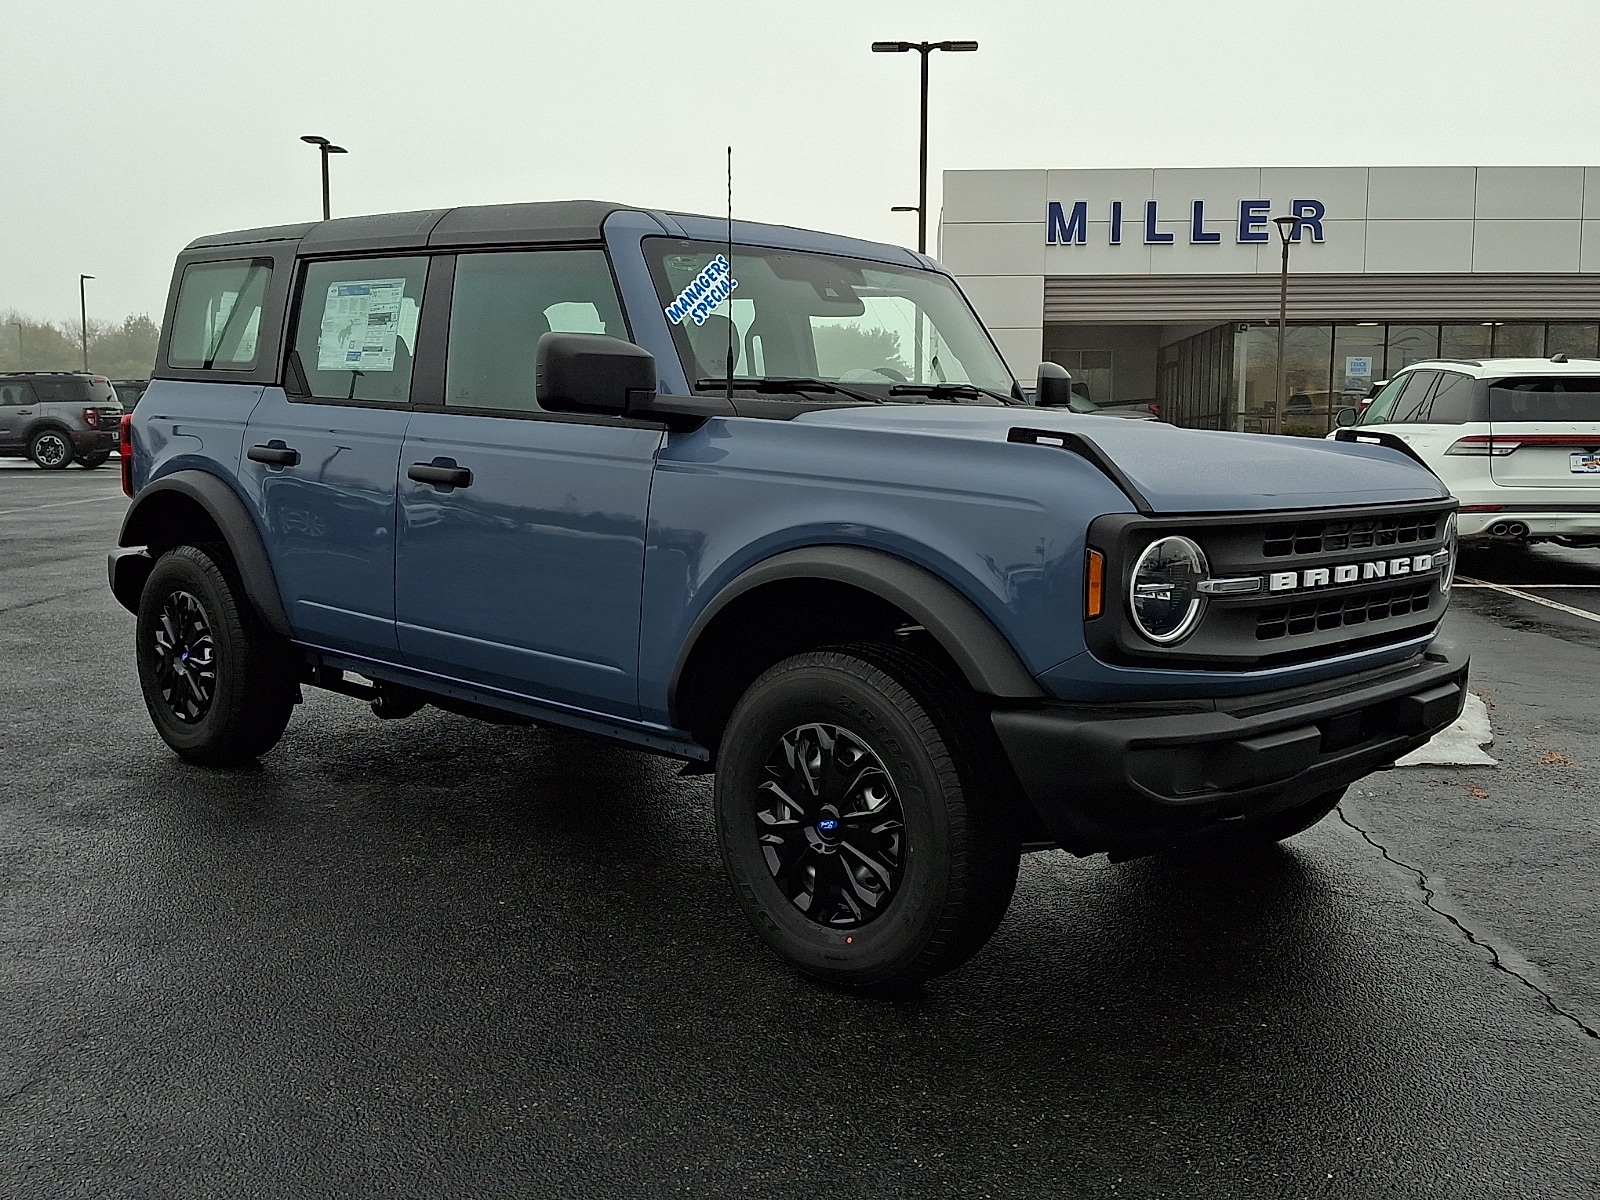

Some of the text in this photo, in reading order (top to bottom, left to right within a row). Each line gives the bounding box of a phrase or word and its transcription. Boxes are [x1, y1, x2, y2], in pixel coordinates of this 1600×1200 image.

[1046, 199, 1326, 244] MILLER
[666, 255, 730, 323] MANAGERS
[1269, 555, 1433, 591] BRONCO
